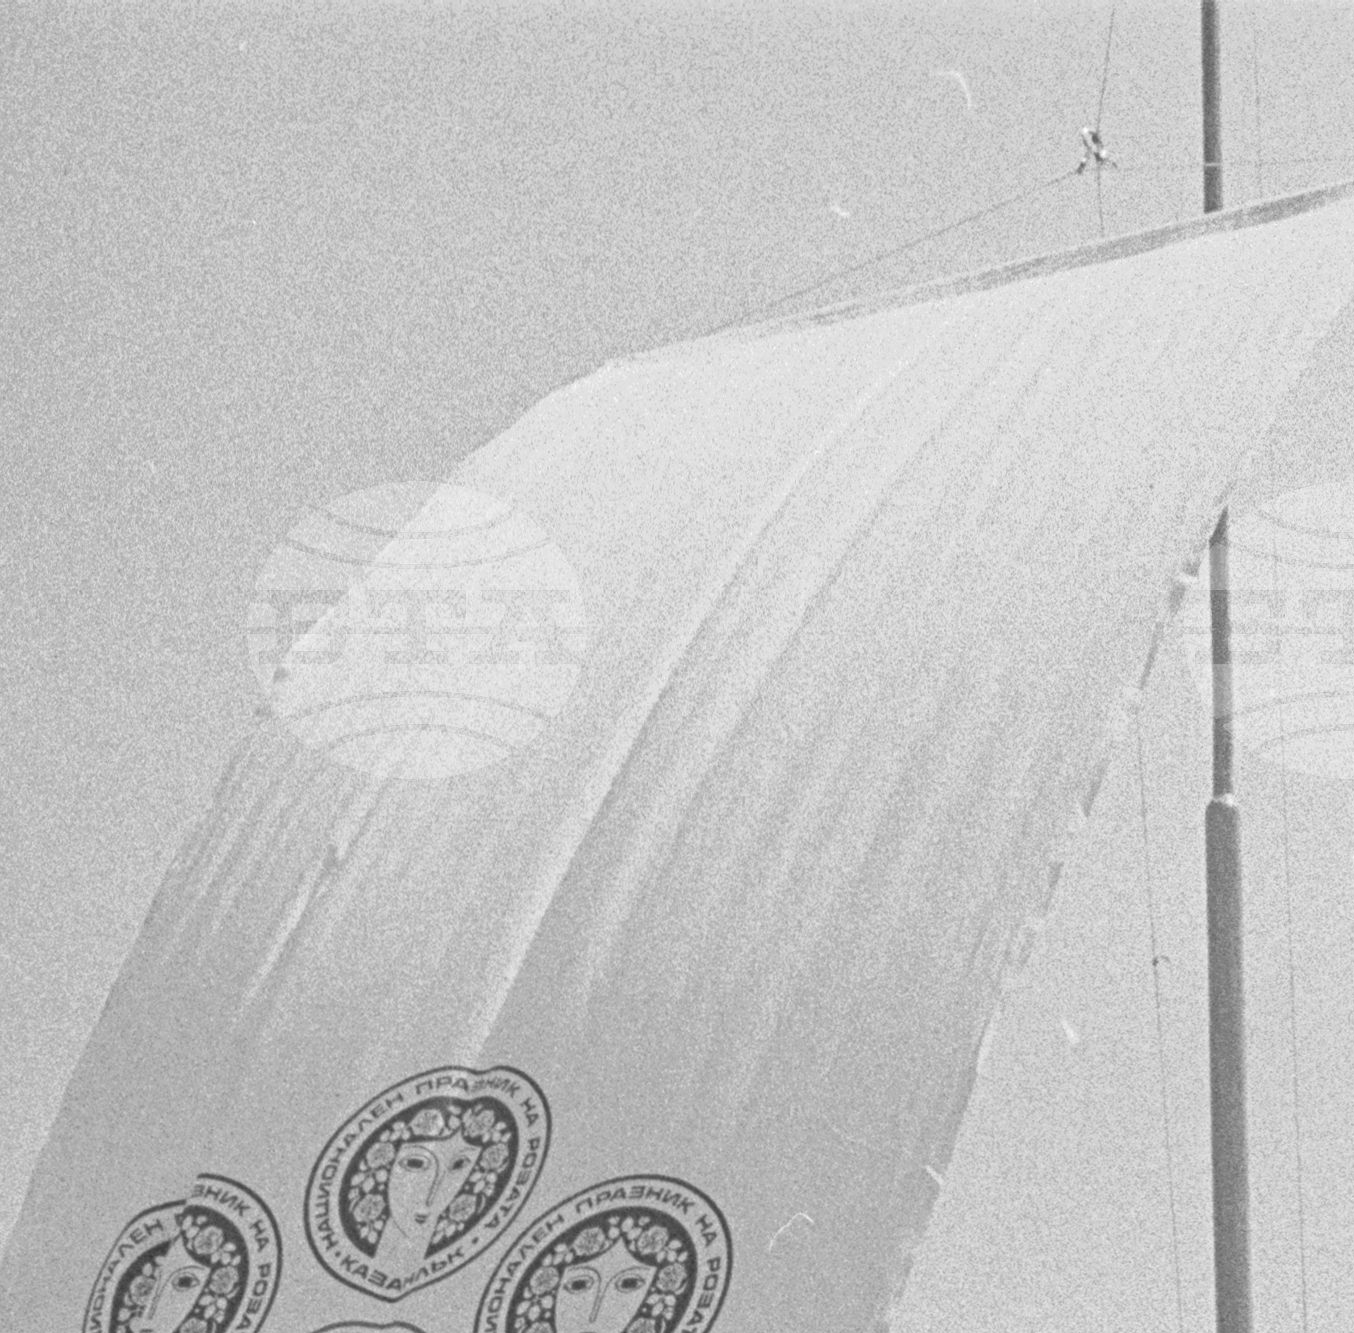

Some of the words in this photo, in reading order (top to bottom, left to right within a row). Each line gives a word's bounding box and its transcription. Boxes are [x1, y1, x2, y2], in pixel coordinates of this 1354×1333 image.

[415, 1076, 521, 1098] ПРАЗНИК
[521, 1098, 540, 1128] НА
[315, 1093, 404, 1250] НАЦИОНАЛЕН
[484, 1136, 540, 1230] РОЗАТА
[250, 1219, 270, 1252] НА
[575, 1185, 695, 1214] ПРАЗНИК
[695, 1214, 718, 1248] НА
[341, 1247, 465, 1290] КАЗАНЛЪК
